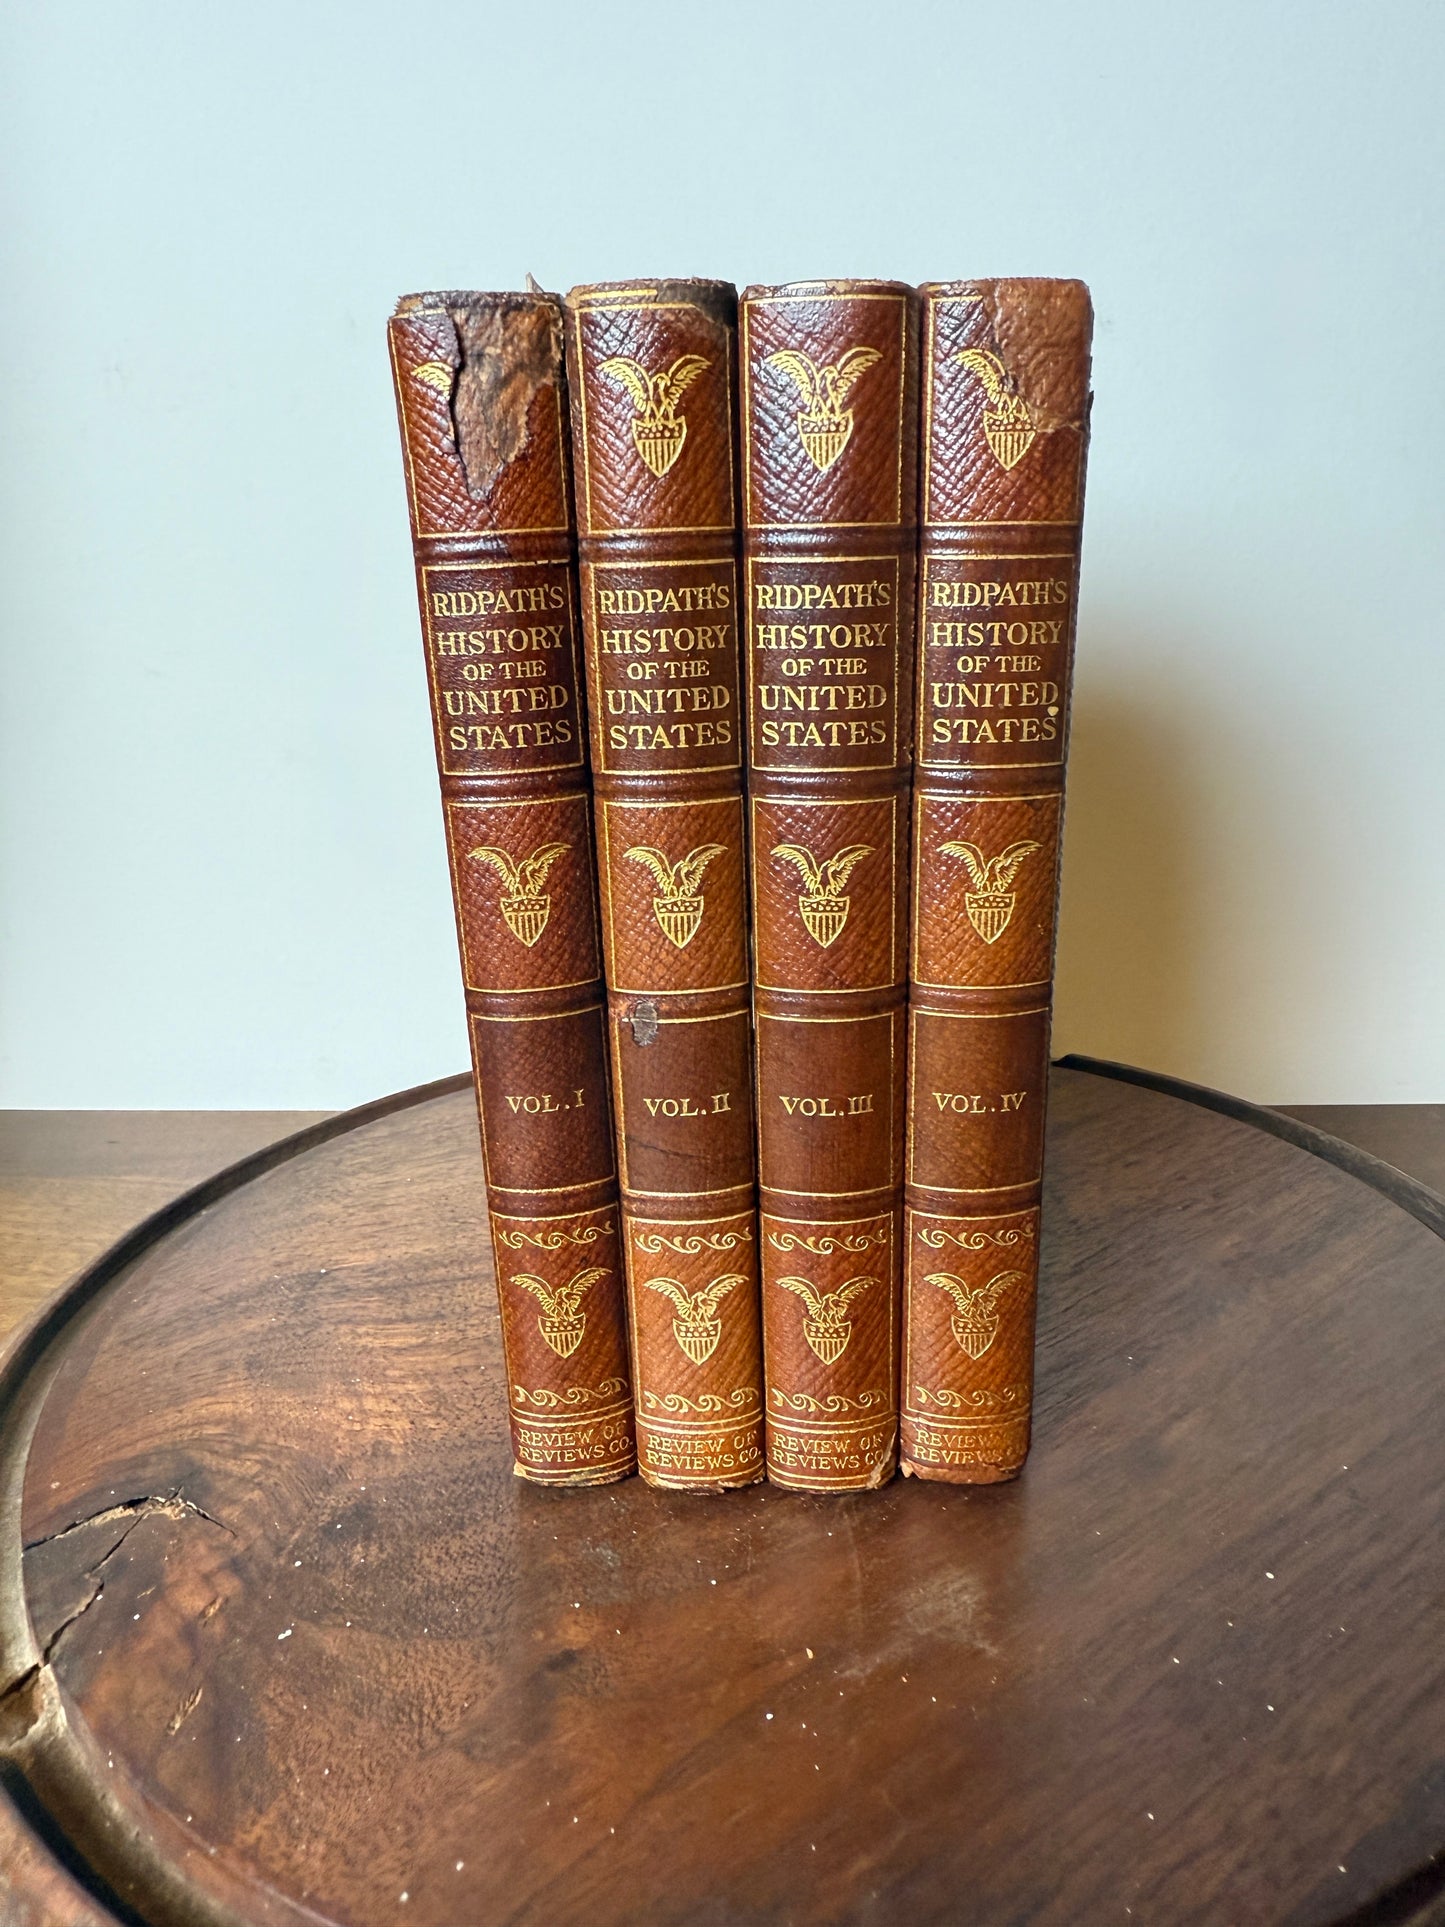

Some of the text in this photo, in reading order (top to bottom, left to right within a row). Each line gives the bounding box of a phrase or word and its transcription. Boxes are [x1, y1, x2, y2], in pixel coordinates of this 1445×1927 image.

[432, 583, 564, 617] RIDPATH'S
[598, 582, 730, 615] RIDPATH'S
[755, 580, 891, 610] RIDPATH'S
[931, 578, 1068, 607] RIDPATH'S
[437, 625, 565, 656] HISTORY
[600, 624, 731, 654] HISTORY
[756, 623, 891, 650] HISTORY
[929, 620, 1064, 648] HISTORY
[463, 660, 547, 681] OF THE
[626, 660, 710, 680] OF THE
[781, 657, 868, 676] OF THE
[956, 654, 1042, 673] OF THE
[443, 685, 569, 716] UNITED
[605, 685, 731, 715] UNITED
[758, 684, 887, 711] UNITED
[930, 681, 1059, 708] UNITED
[449, 720, 572, 750] STATES
[609, 720, 732, 750] STATES
[761, 720, 888, 747] STATES
[932, 715, 1058, 743] STATES
[505, 1088, 585, 1114] VOL. I
[643, 1092, 732, 1117] VOL. II
[779, 1094, 875, 1117] VOL. III
[932, 1091, 1028, 1114] VOL. IV
[518, 1427, 594, 1448] REVIEW
[647, 1433, 724, 1453] REVIEW
[773, 1432, 851, 1454] REVIEW
[518, 1444, 606, 1463] REVIEWS
[645, 1449, 735, 1470] REVIEWS
[771, 1447, 860, 1470] REVIEWS
